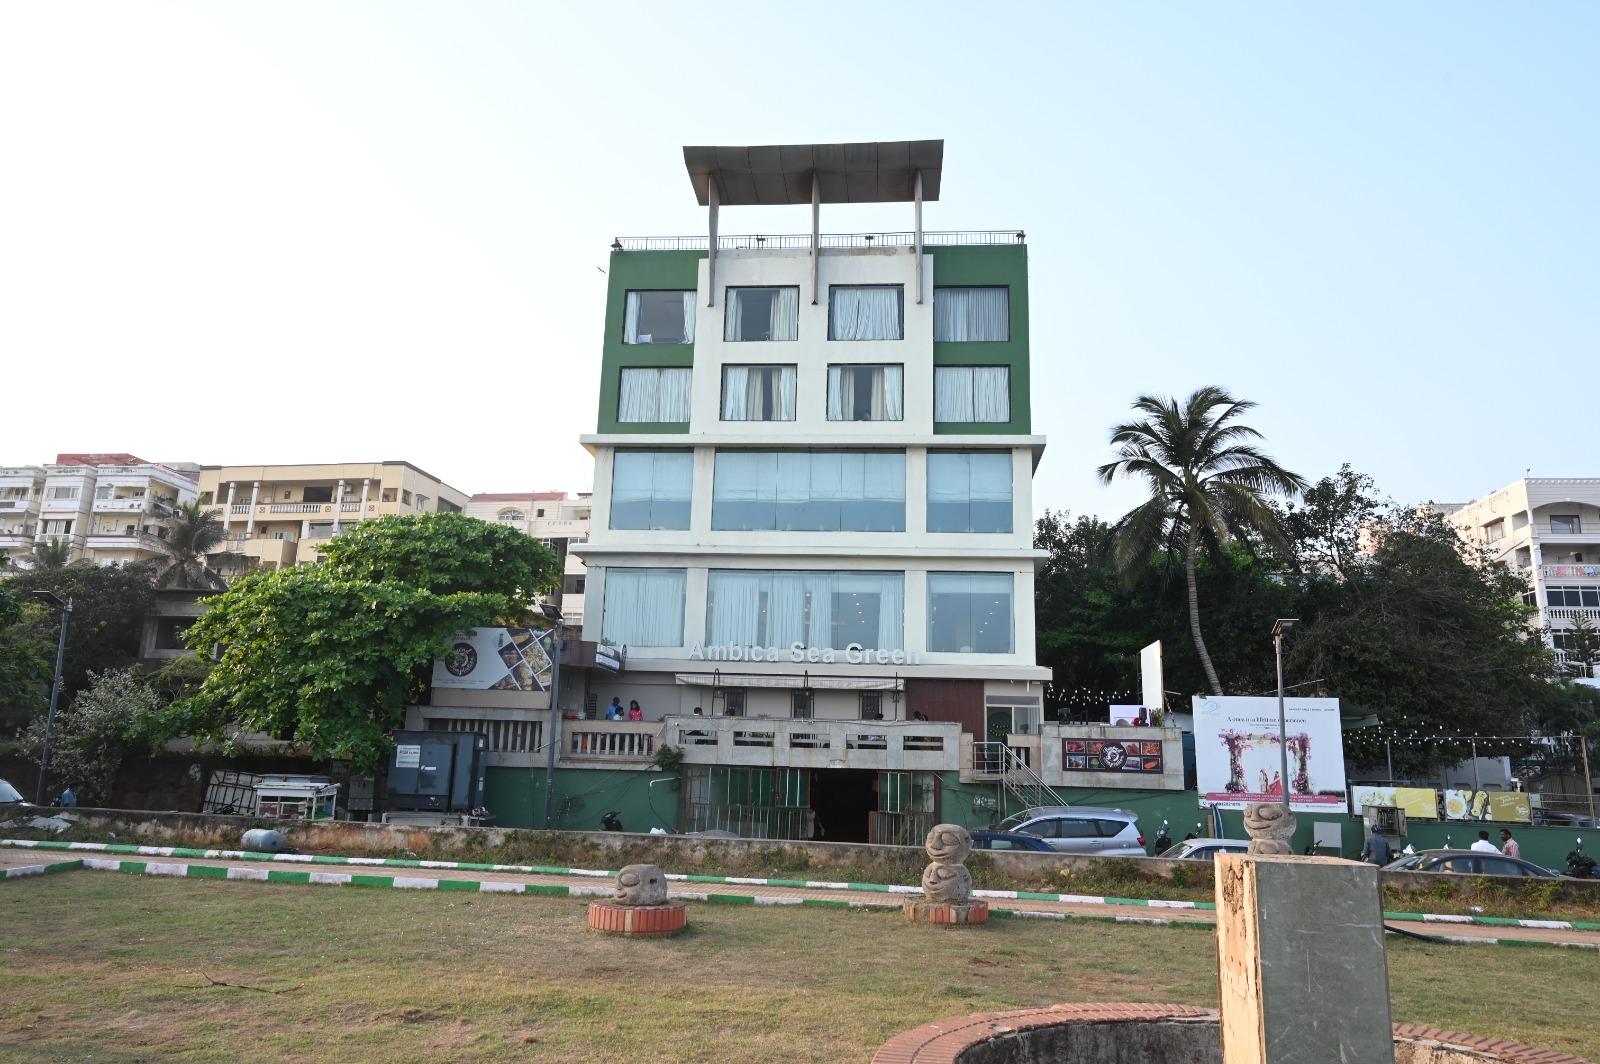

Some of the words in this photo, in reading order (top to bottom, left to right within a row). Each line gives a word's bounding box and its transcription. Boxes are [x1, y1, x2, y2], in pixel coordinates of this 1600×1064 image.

[689, 639, 779, 662] Ambica
[790, 641, 835, 664] Sea
[845, 642, 920, 666] Green
